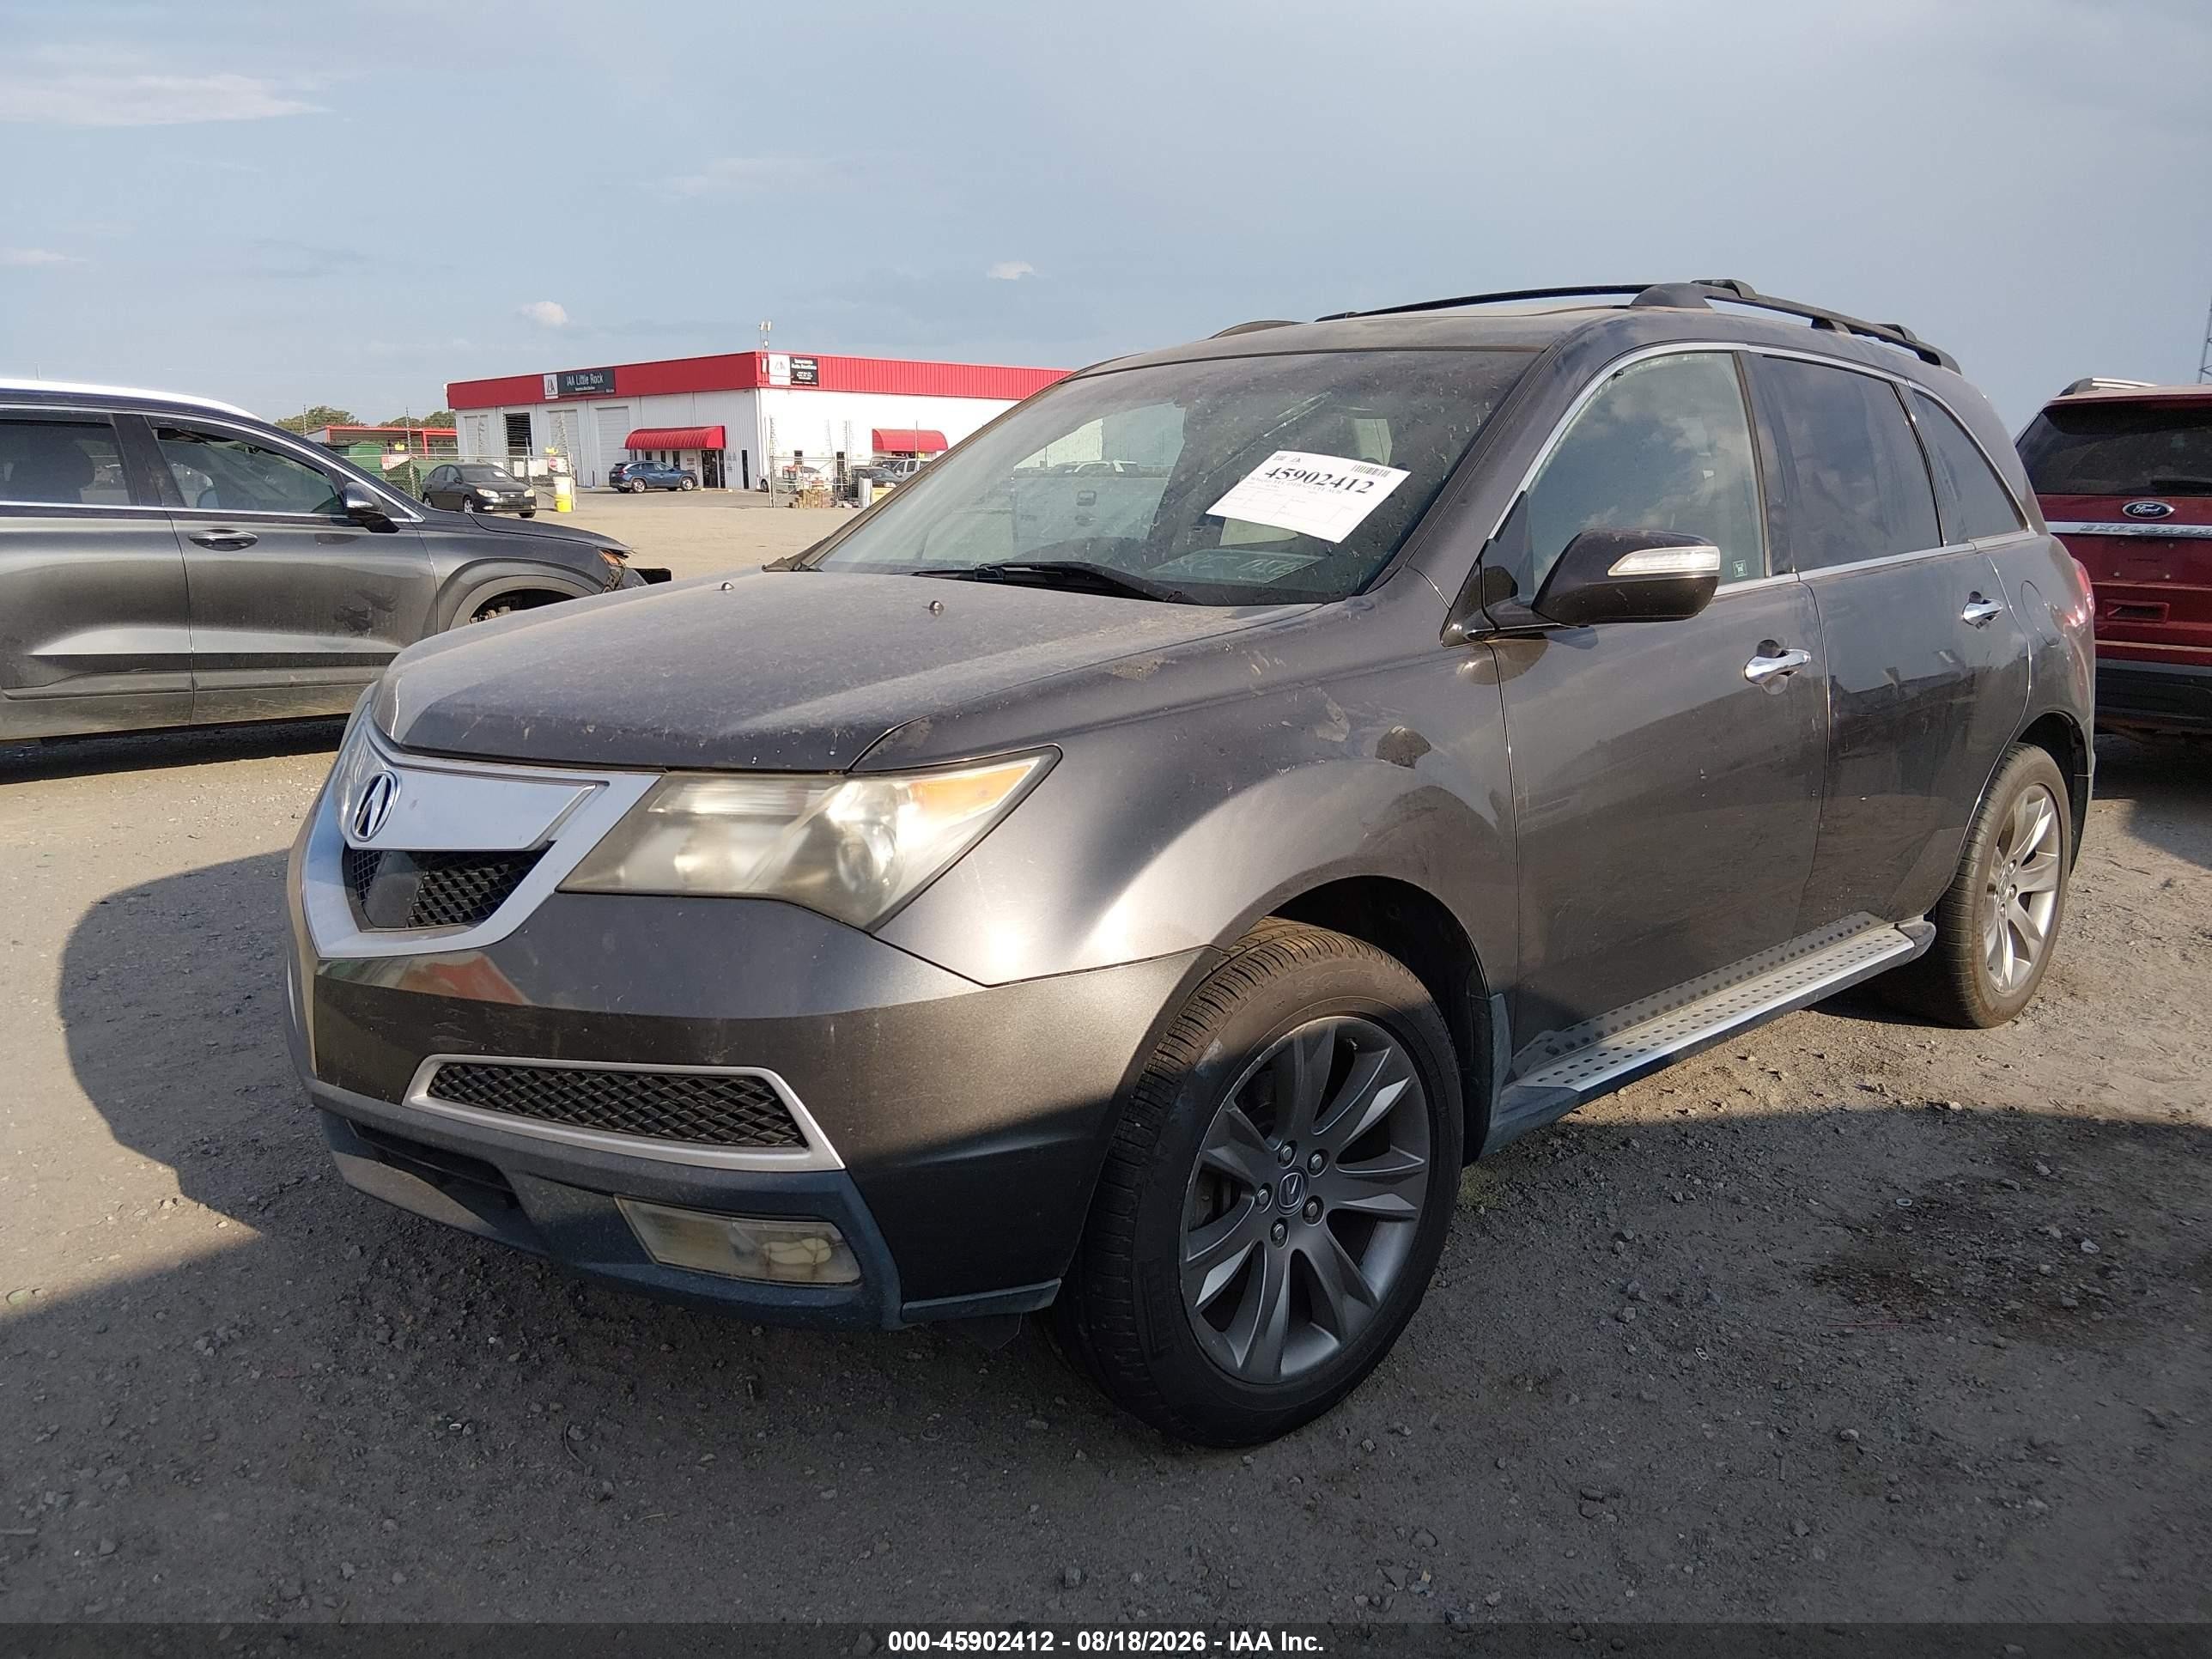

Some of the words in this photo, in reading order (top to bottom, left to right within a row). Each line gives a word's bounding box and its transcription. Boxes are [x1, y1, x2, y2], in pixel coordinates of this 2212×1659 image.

[567, 375, 575, 386] IAA
[575, 374, 589, 386] Little
[590, 373, 604, 385] Rock
[1265, 466, 1375, 495] 45902412
[2132, 503, 2162, 515] Ford
